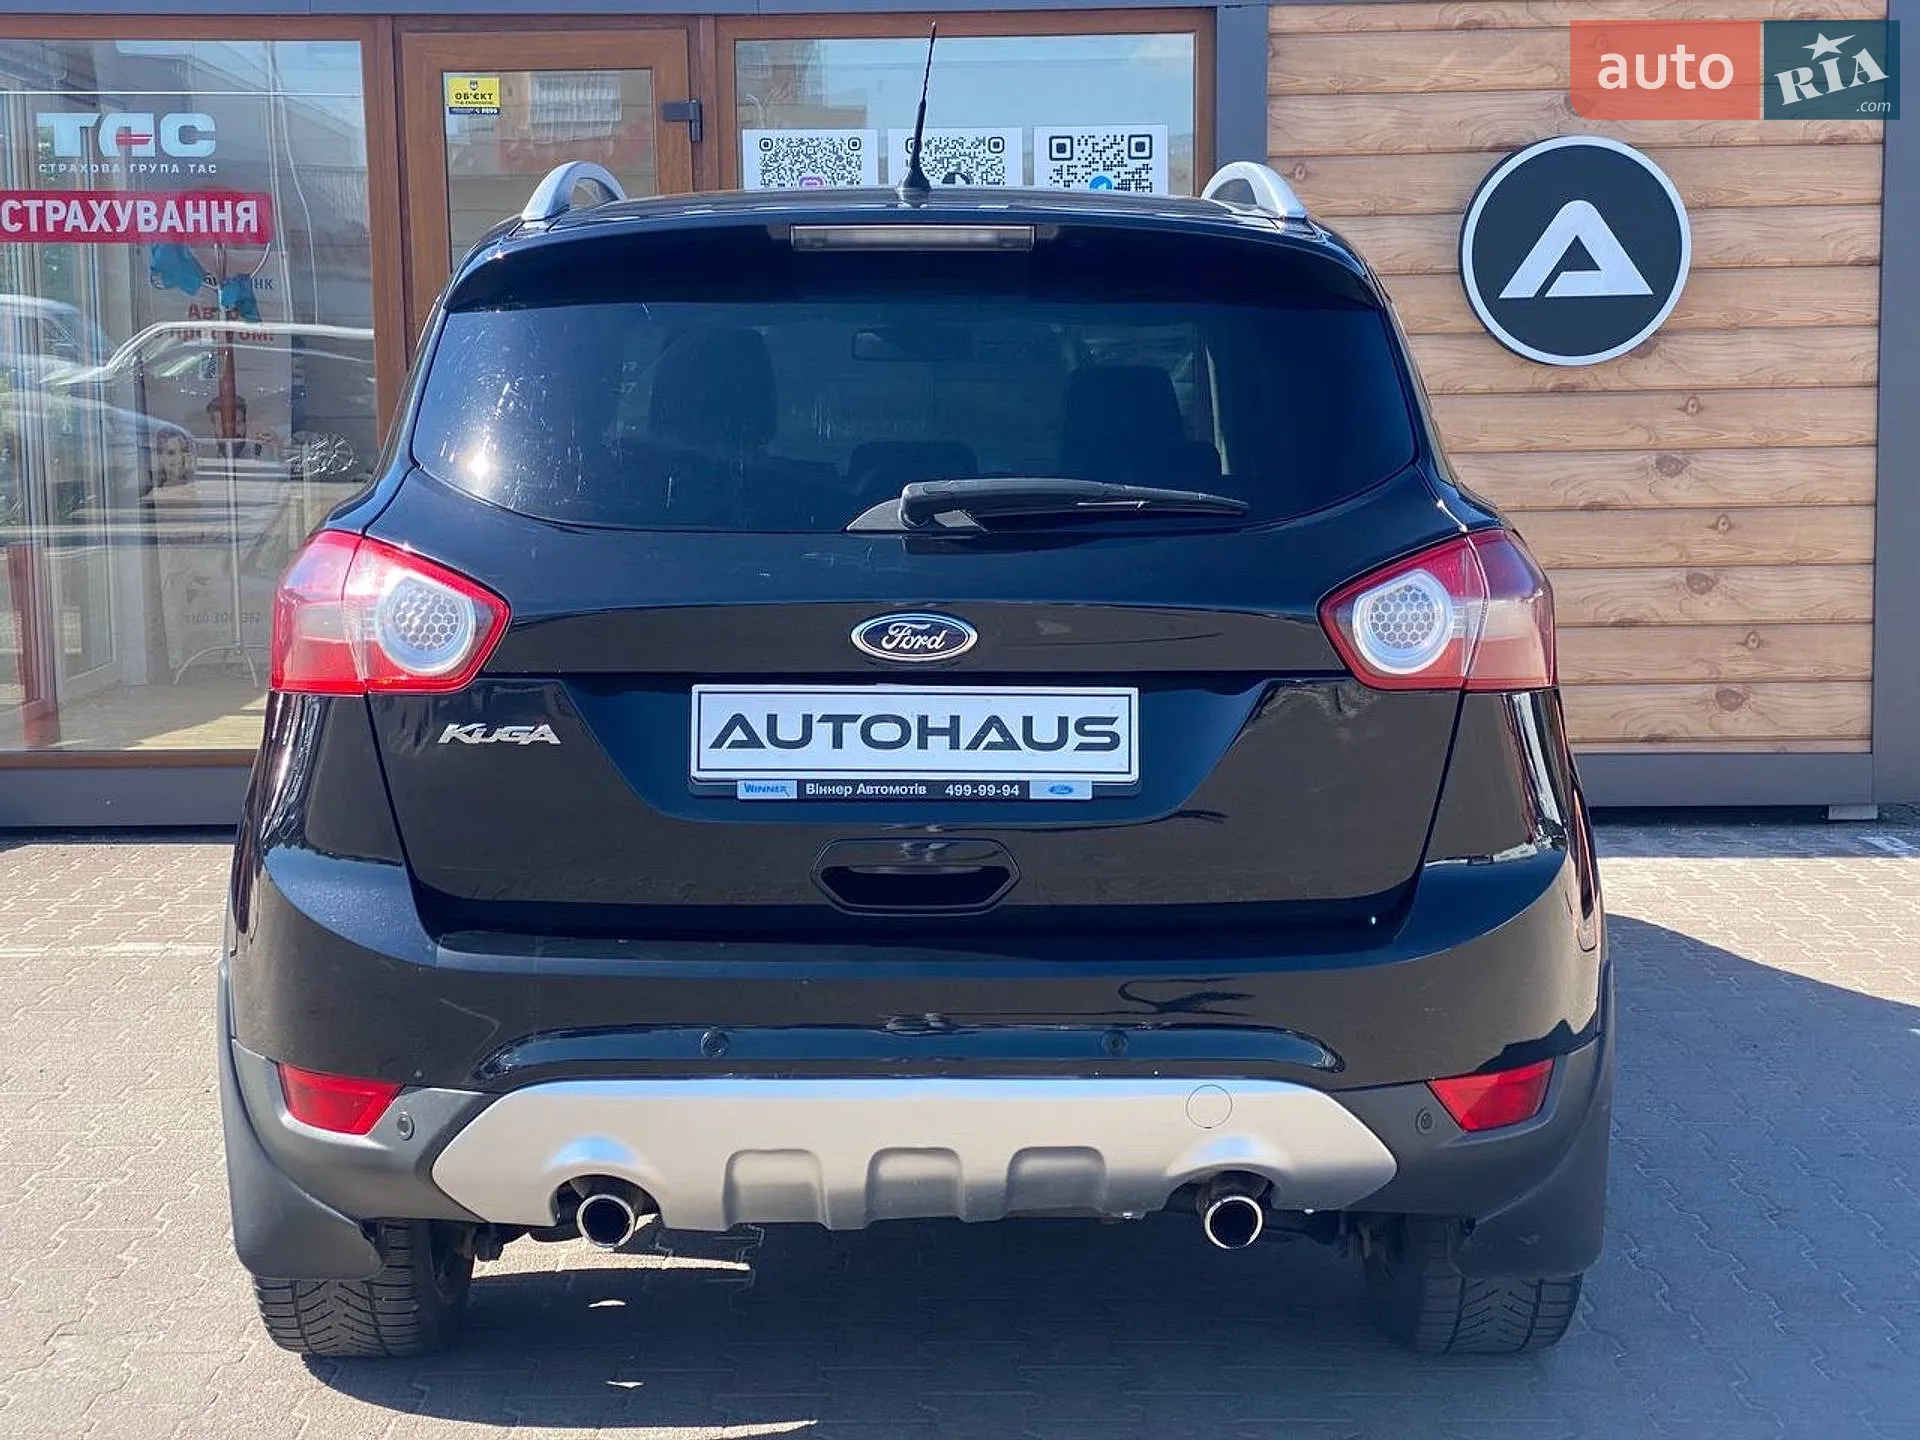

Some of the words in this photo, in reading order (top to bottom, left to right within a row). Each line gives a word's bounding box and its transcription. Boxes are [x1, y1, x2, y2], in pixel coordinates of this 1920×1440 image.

[38, 163, 120, 175] СТРАХОВА
[129, 163, 180, 175] ГРУПА
[189, 163, 217, 175] ТАС
[1, 200, 259, 233] СТРАХУВАННЯ
[880, 623, 947, 651] Ford
[437, 722, 562, 745] KUGA
[708, 711, 1121, 752] AUTOHAUS
[805, 783, 853, 797] Віннер
[856, 782, 928, 796] Автомотів
[944, 784, 1020, 797] 499-99-94
